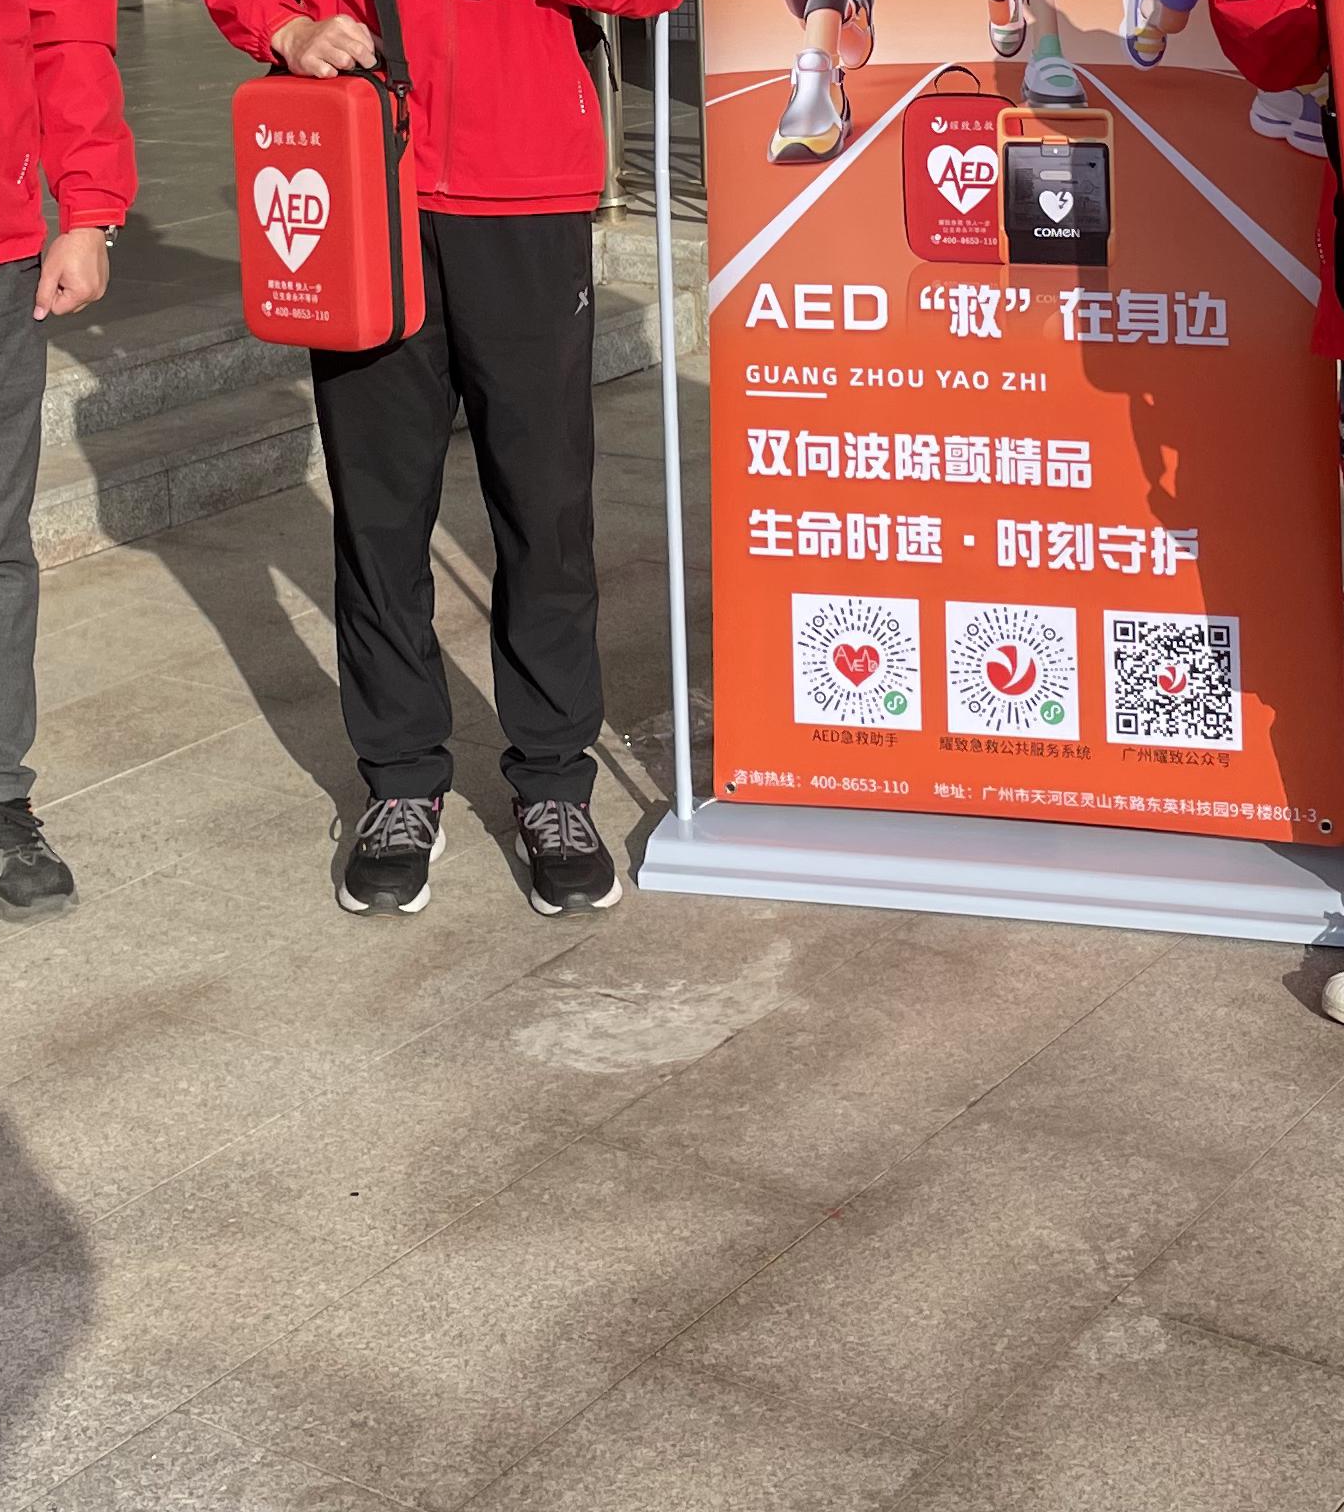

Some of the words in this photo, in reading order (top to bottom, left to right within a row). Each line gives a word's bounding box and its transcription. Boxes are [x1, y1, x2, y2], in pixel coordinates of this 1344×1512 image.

[939, 154, 995, 183] AED
[267, 184, 324, 226] AED
[745, 283, 888, 332] AED
[1060, 288, 1229, 348] 在身边
[745, 365, 839, 387] GUANG
[849, 368, 925, 389] ZHOU
[936, 369, 991, 391] YAO
[1001, 372, 1049, 393] ZHI
[746, 428, 1093, 490] 双向波除颤精品
[812, 729, 898, 748] AED急救助手
[939, 736, 1092, 761] 耀致急救公共服务系统
[1122, 746, 1231, 768] 广州耀致公众号
